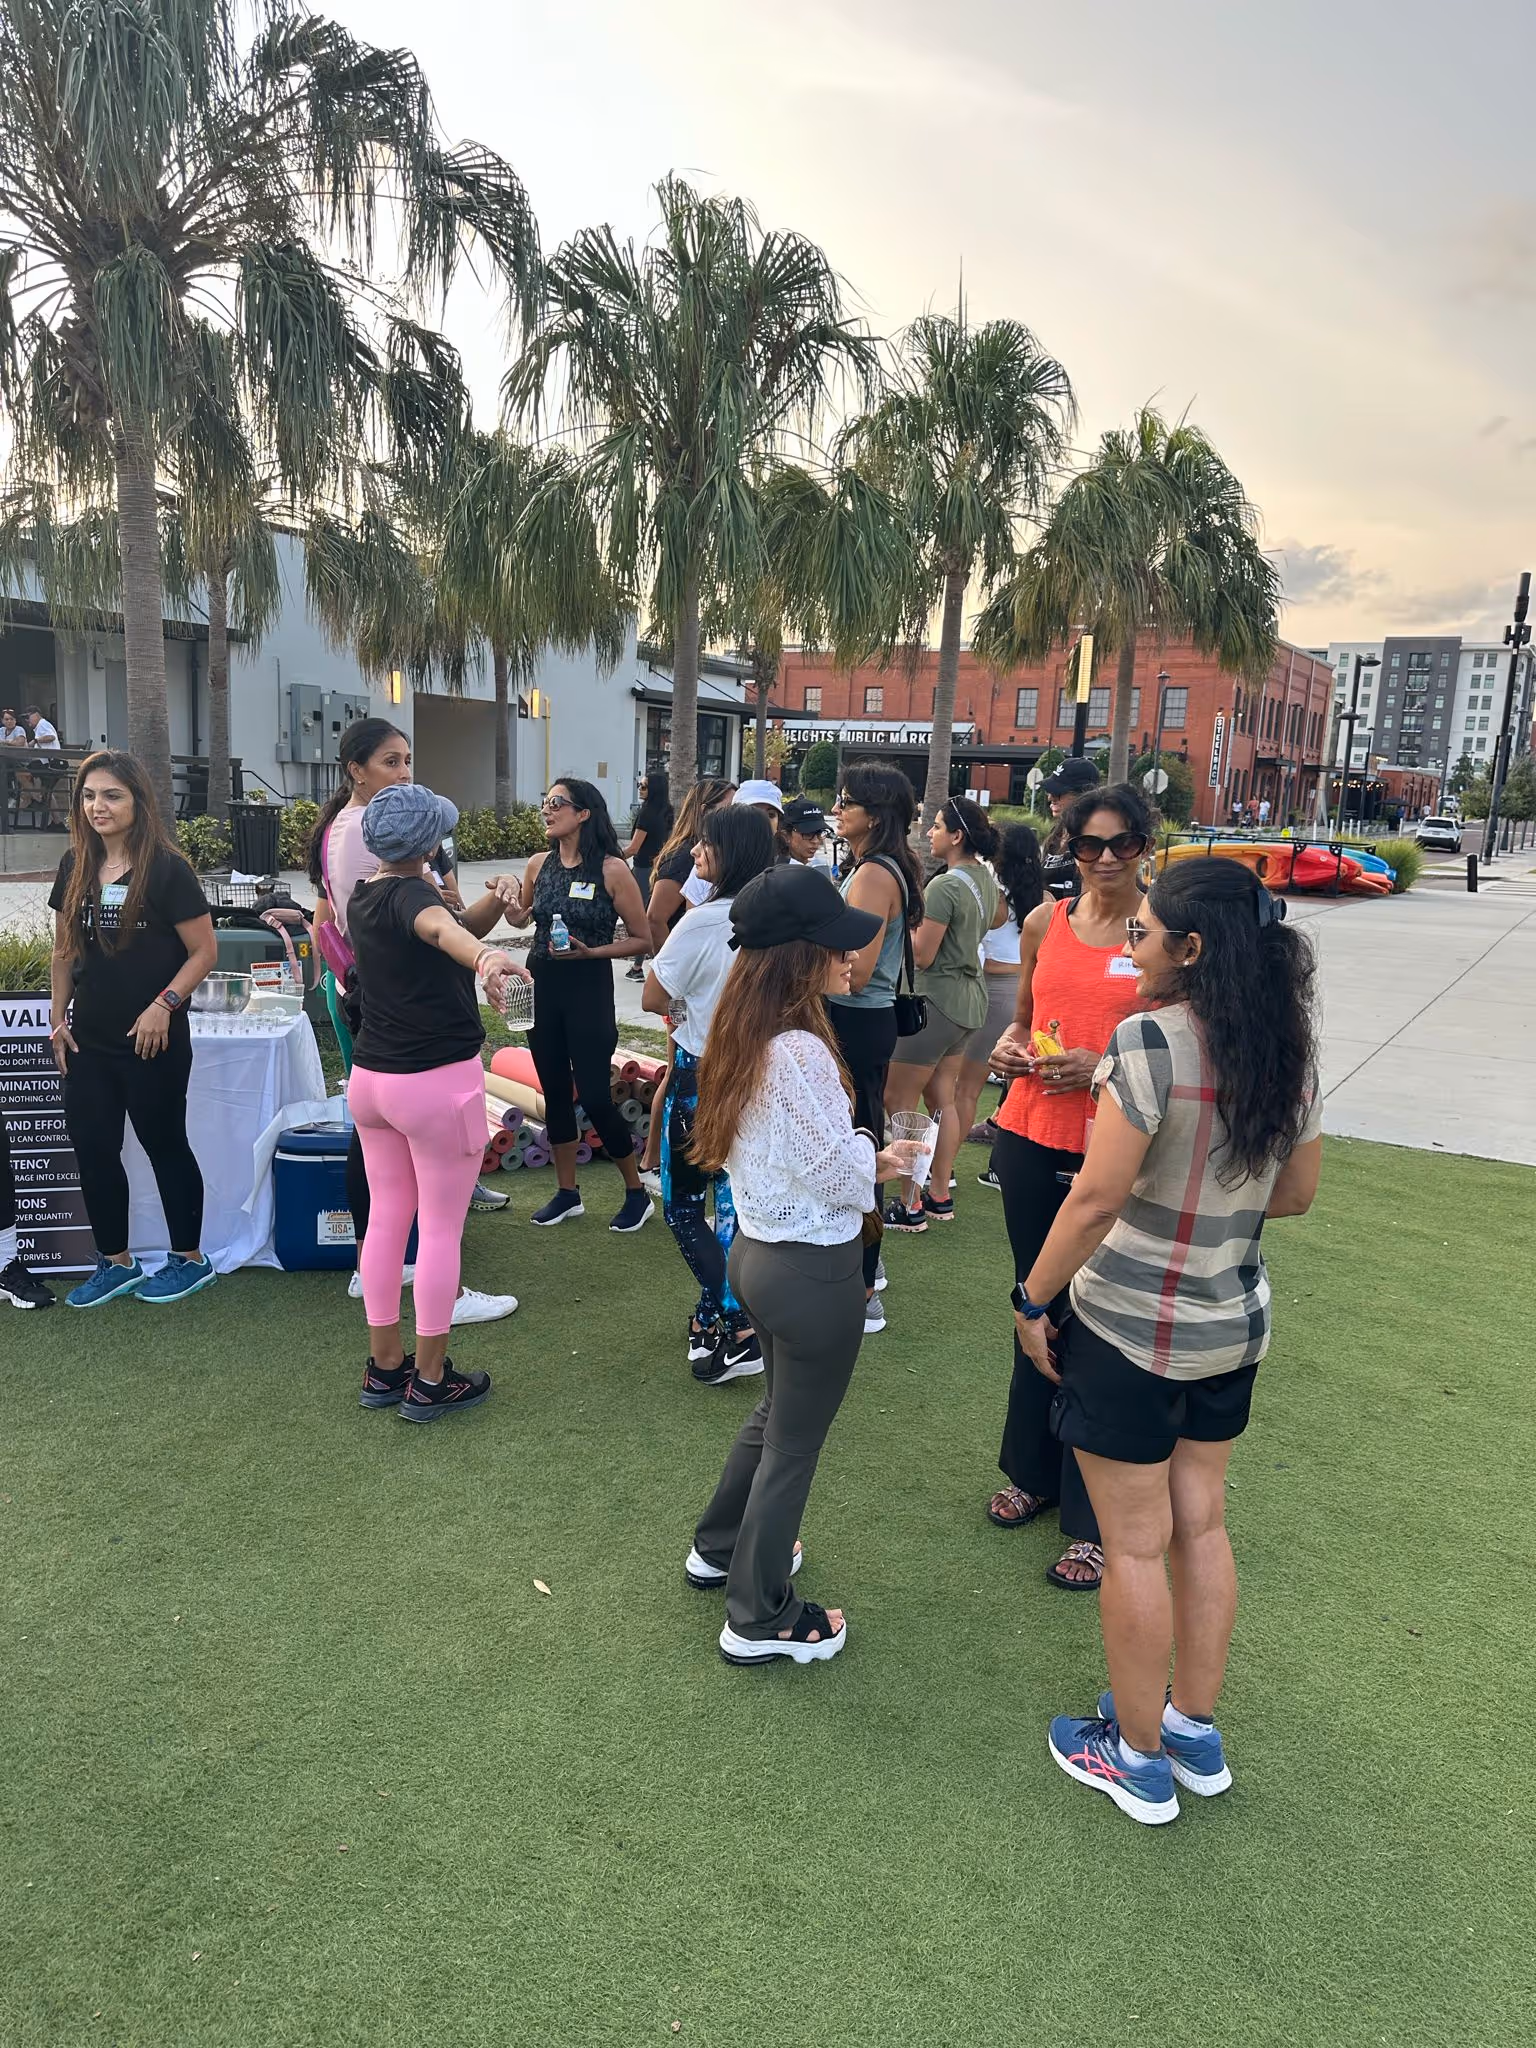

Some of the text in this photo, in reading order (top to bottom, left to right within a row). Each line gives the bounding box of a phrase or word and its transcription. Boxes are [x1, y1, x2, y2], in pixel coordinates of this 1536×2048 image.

[782, 729, 834, 743] HEIGHTS
[839, 731, 885, 743] PUBLIC
[1211, 719, 1223, 785] STEELBACH
[38, 1057, 54, 1065] FEEL
[8, 1095, 44, 1103] NOTHING
[45, 1094, 62, 1102] CAN
[5, 1120, 32, 1131] AND
[17, 1135, 34, 1143] CAN
[35, 1134, 71, 1142] CONTROL
[36, 1173, 55, 1181] INTO
[35, 1212, 73, 1221] QUANTITY
[332, 1223, 349, 1235] USA
[23, 1253, 50, 1261] DRIVES
[51, 1252, 62, 1260] US
